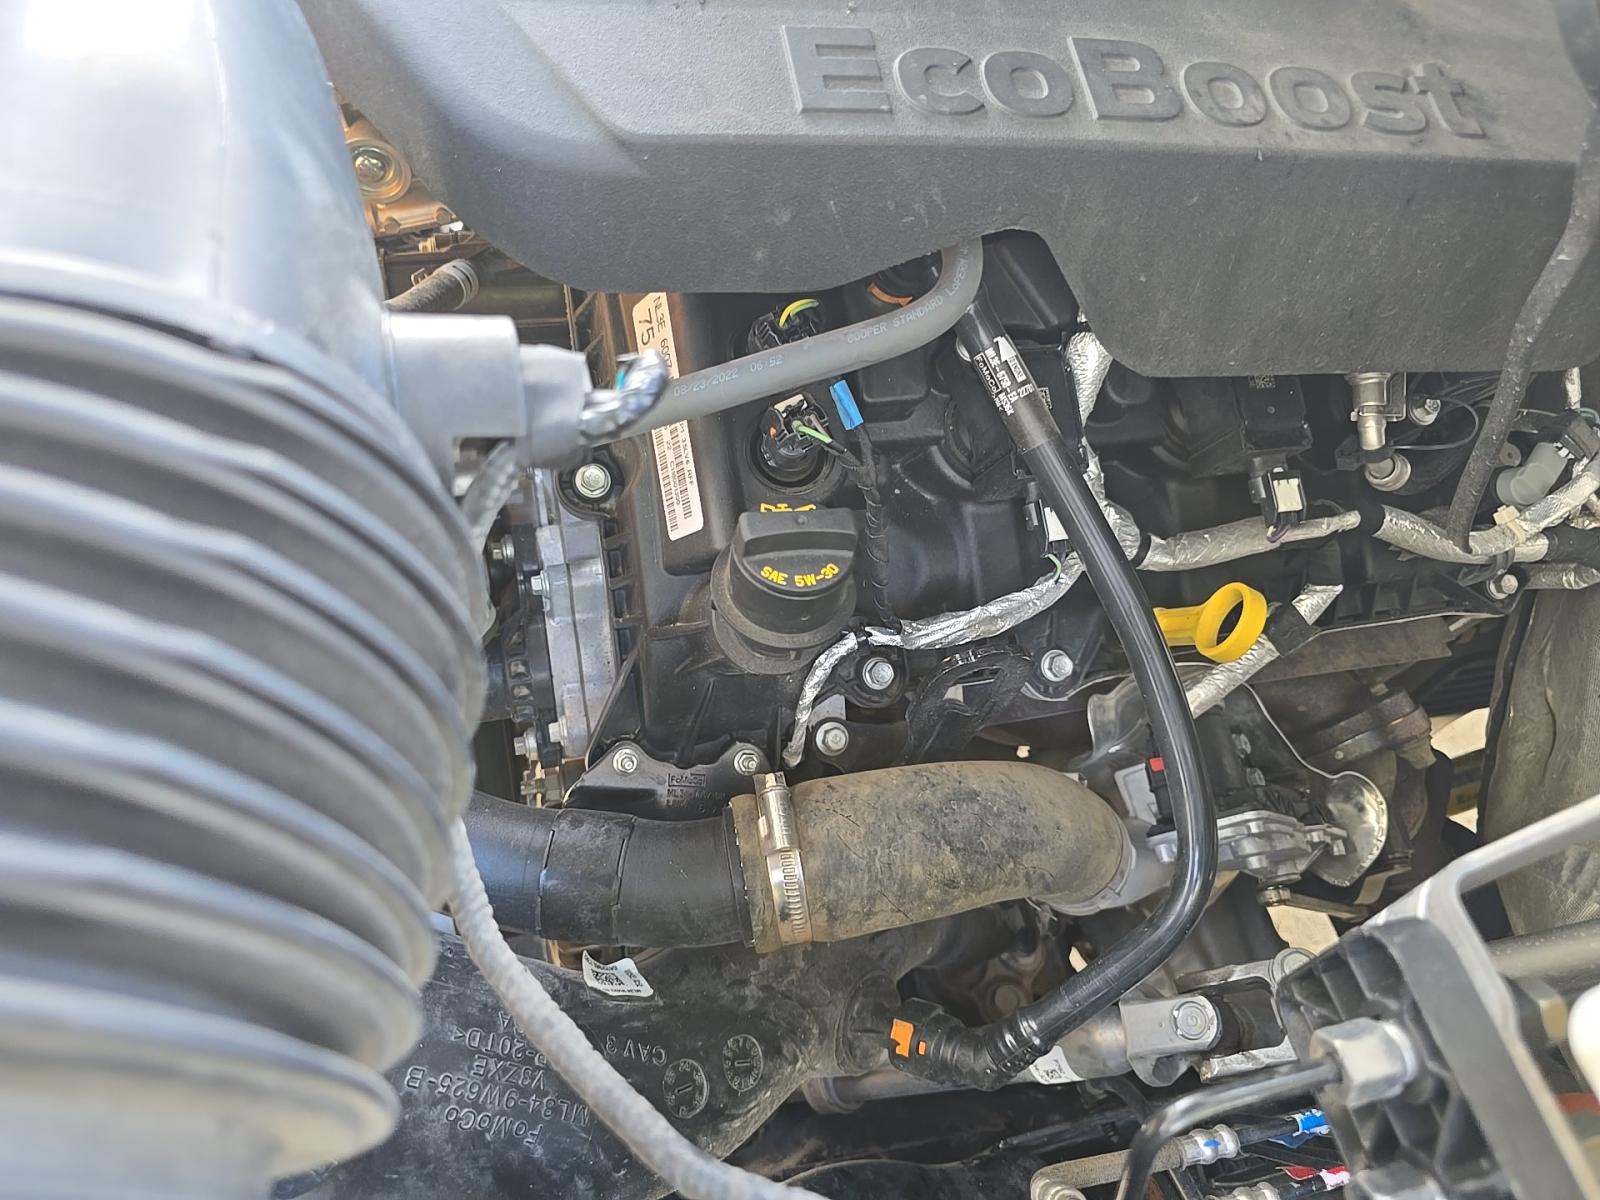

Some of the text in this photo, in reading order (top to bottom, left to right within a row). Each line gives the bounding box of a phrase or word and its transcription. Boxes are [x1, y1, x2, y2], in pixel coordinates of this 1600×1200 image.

[781, 24, 1488, 139] EcoBoost
[638, 307, 655, 346] 75
[893, 294, 944, 328] STANDARD
[975, 356, 998, 393] FoMoCo
[761, 563, 840, 587] SAE 5W-30
[605, 1032, 667, 1067] CAV 3
[445, 1105, 544, 1146] FoMoCo
